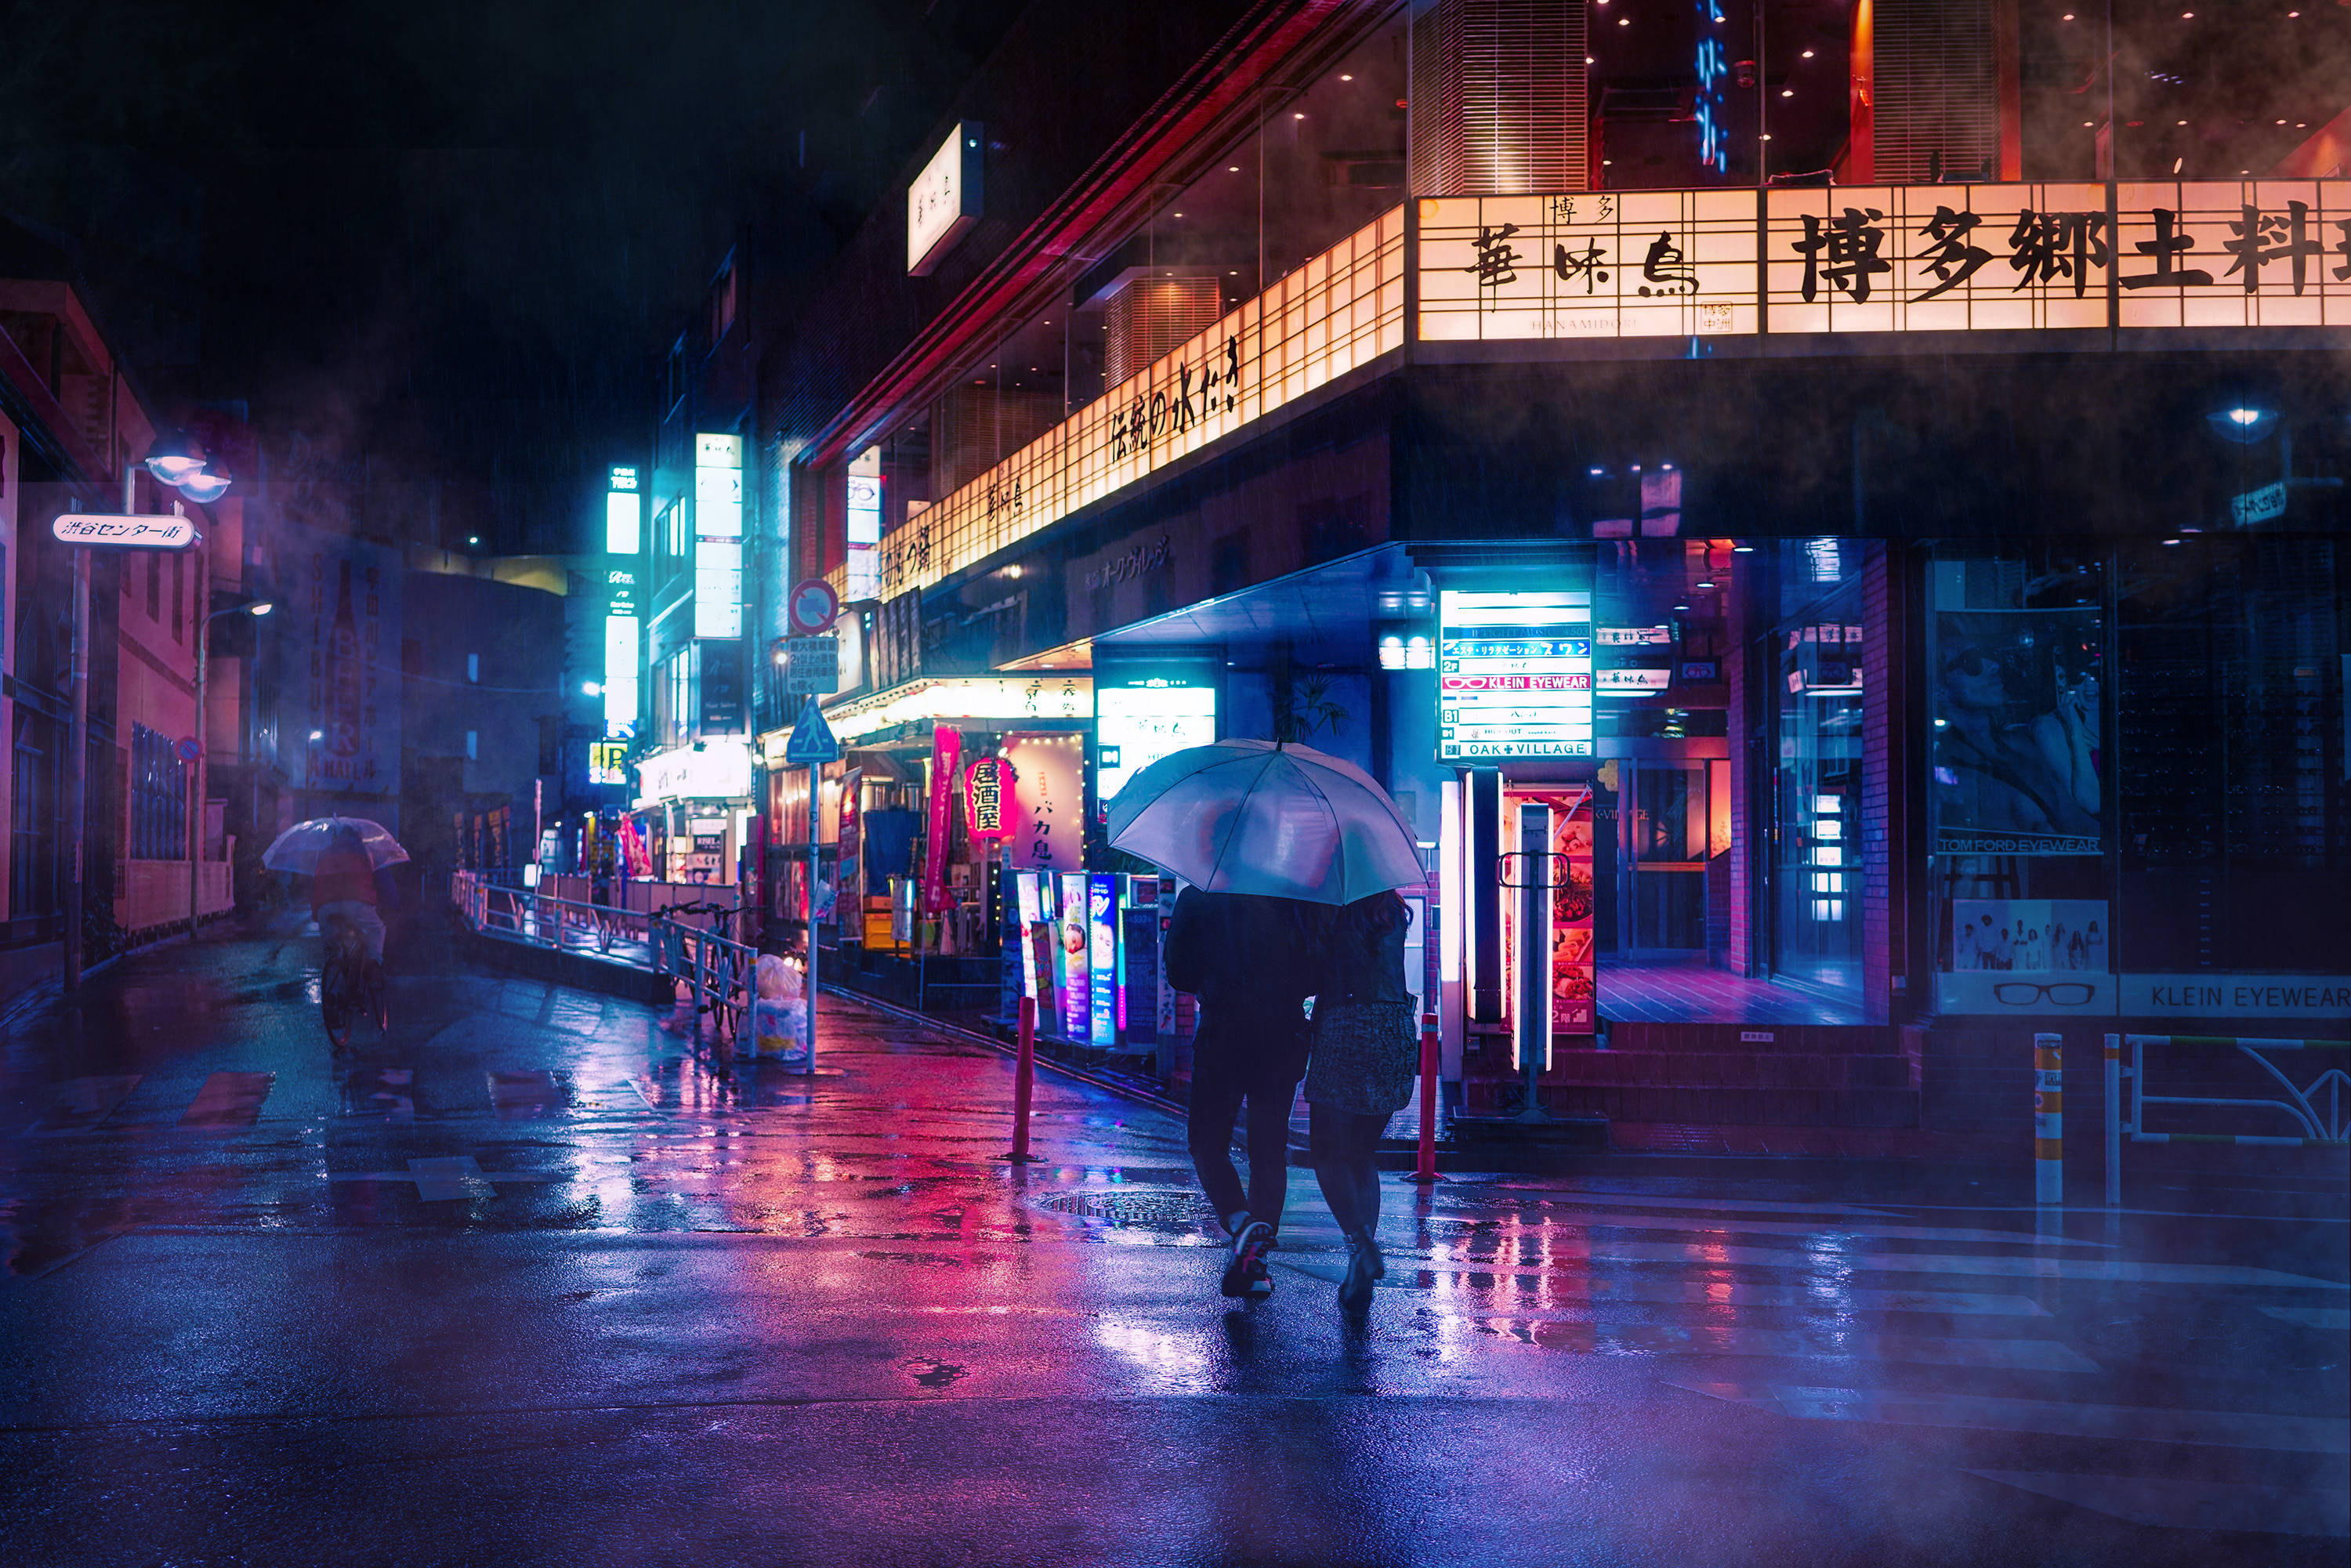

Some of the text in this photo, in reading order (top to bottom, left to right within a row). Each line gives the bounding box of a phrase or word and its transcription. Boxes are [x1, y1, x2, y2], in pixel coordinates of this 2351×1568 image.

[1549, 195, 1614, 225] 博多
[1791, 199, 2351, 305] 博多郷土料
[1464, 223, 1700, 313] 華味鳥
[1531, 318, 1639, 331] HANAMIDORI
[61, 520, 183, 541] 渋谷センター街
[1541, 643, 1588, 656] スワン
[1443, 661, 1458, 672] 2F
[1489, 676, 1588, 689] KLEIN EYEWEAR
[1443, 709, 1458, 722] B1
[1469, 744, 1585, 755] OAK VILLAGE
[324, 759, 361, 780] HALL
[971, 762, 1002, 831] 居酒屋
[1940, 839, 2099, 853] TOM FORD EYEWEAR
[2152, 987, 2351, 1007] KLEIN EYEWEAR
